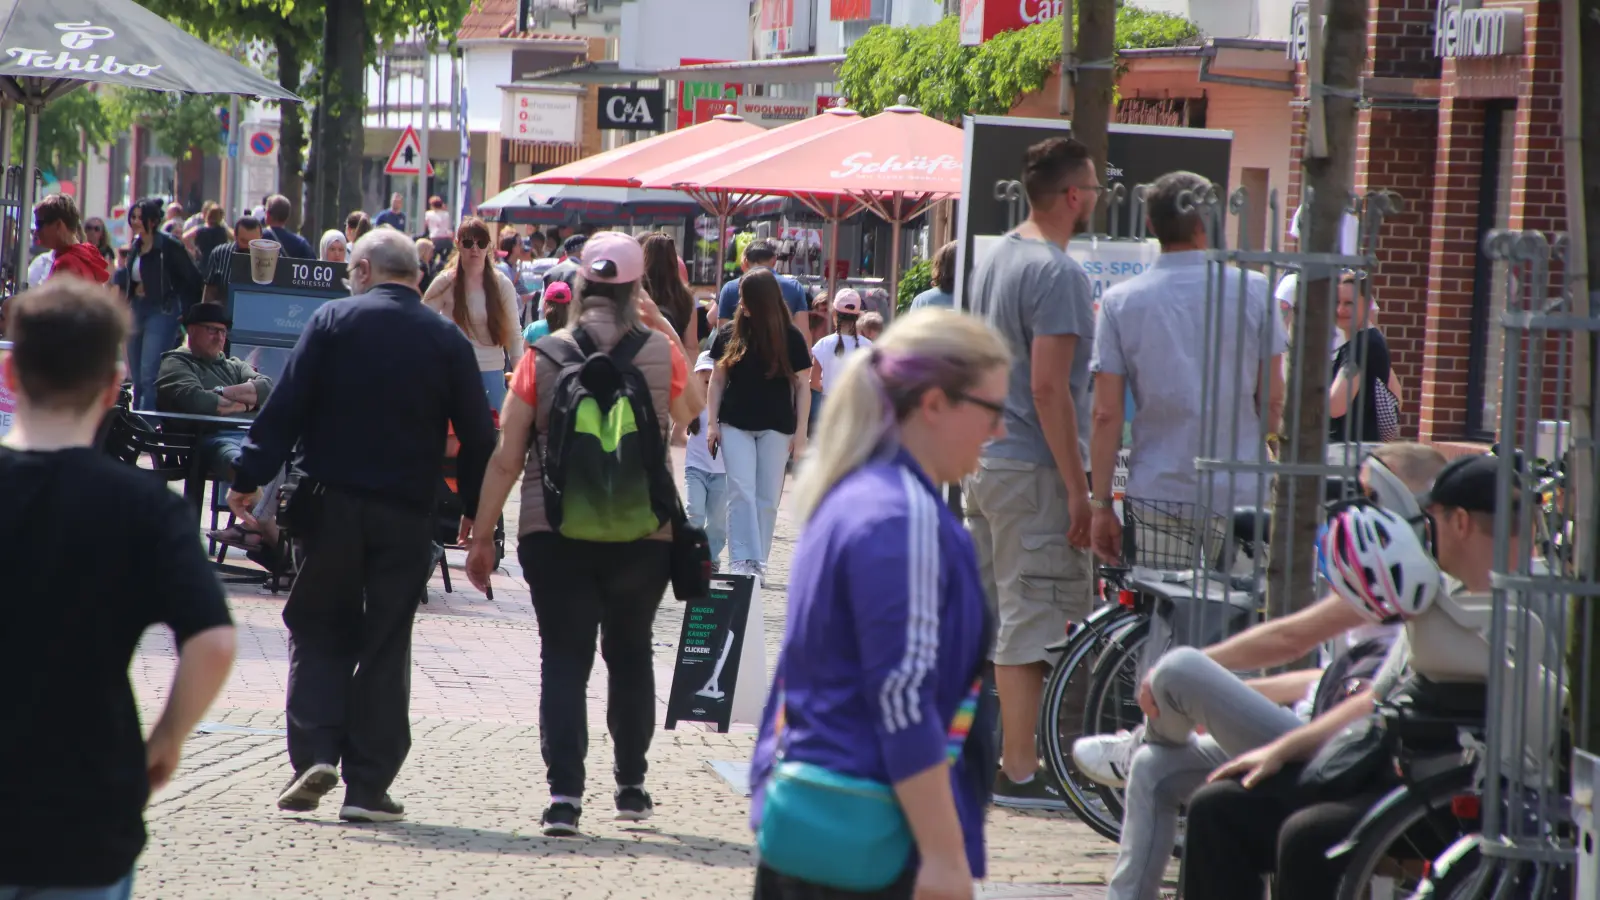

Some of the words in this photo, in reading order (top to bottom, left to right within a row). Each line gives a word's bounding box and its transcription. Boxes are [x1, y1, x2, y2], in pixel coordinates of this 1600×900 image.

[6, 47, 162, 77] Tchibo
[606, 95, 654, 125] C&A
[744, 103, 809, 115] WOOLWORTH
[830, 151, 963, 179] Schäfe
[292, 264, 309, 280] TO
[313, 265, 333, 282] GO
[292, 280, 331, 288] GENIESSEN
[691, 606, 715, 615] SAUGEN
[684, 646, 711, 654] CLICKEN!
